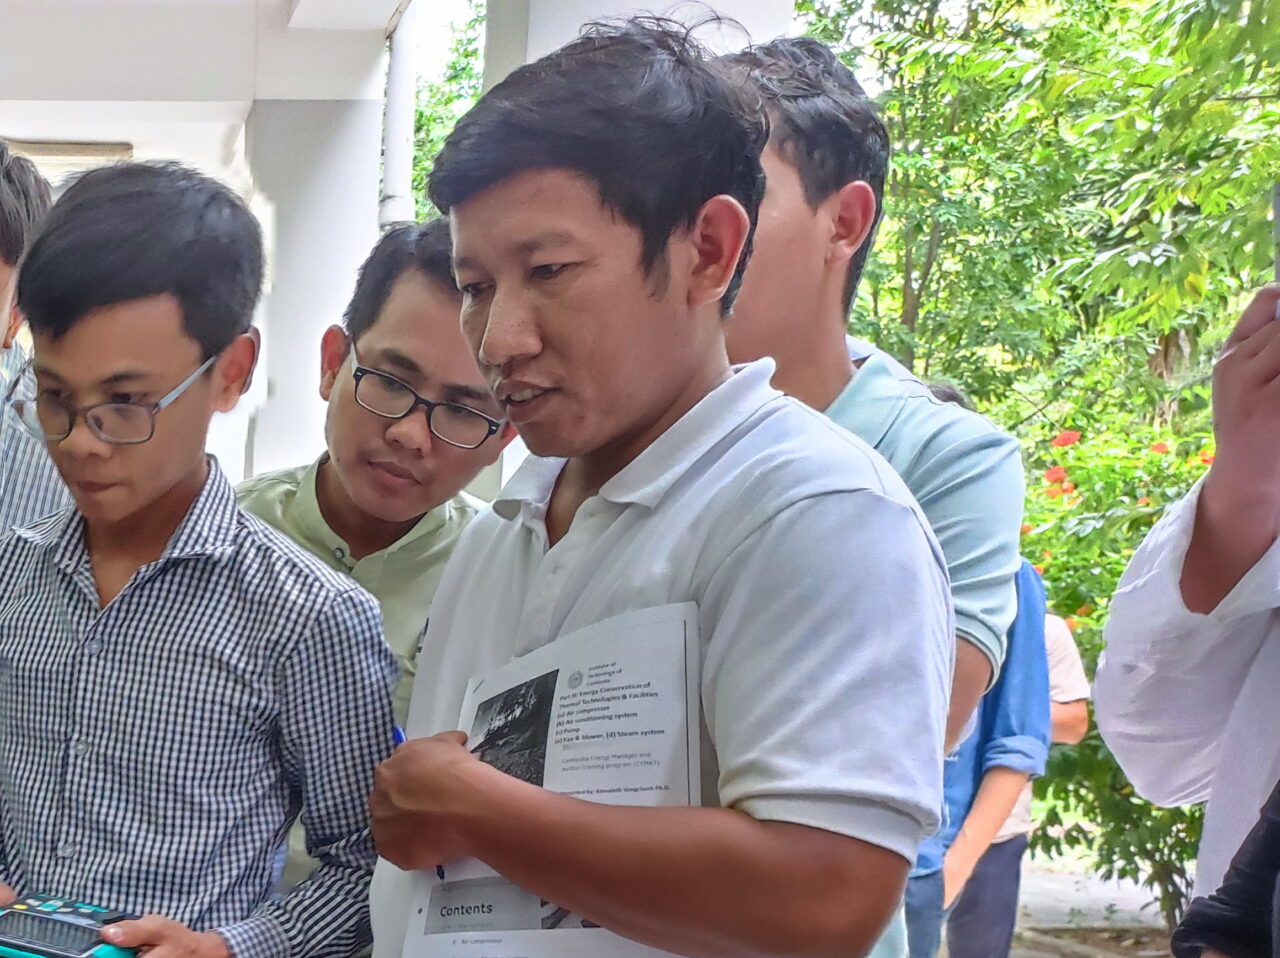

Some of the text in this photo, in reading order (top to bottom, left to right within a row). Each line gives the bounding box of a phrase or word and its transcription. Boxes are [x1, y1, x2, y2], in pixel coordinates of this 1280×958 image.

[579, 689, 598, 698] Energy
[599, 683, 643, 693] Conservation
[643, 681, 651, 689] of
[559, 700, 581, 709] Thermal
[581, 694, 621, 705] Technologies
[629, 691, 659, 699] Facilities
[575, 713, 613, 723] conditioning
[614, 711, 638, 720] system
[606, 731, 616, 739] (d)
[640, 728, 665, 736] system
[590, 754, 610, 762] Energy
[439, 902, 494, 918] Contents
